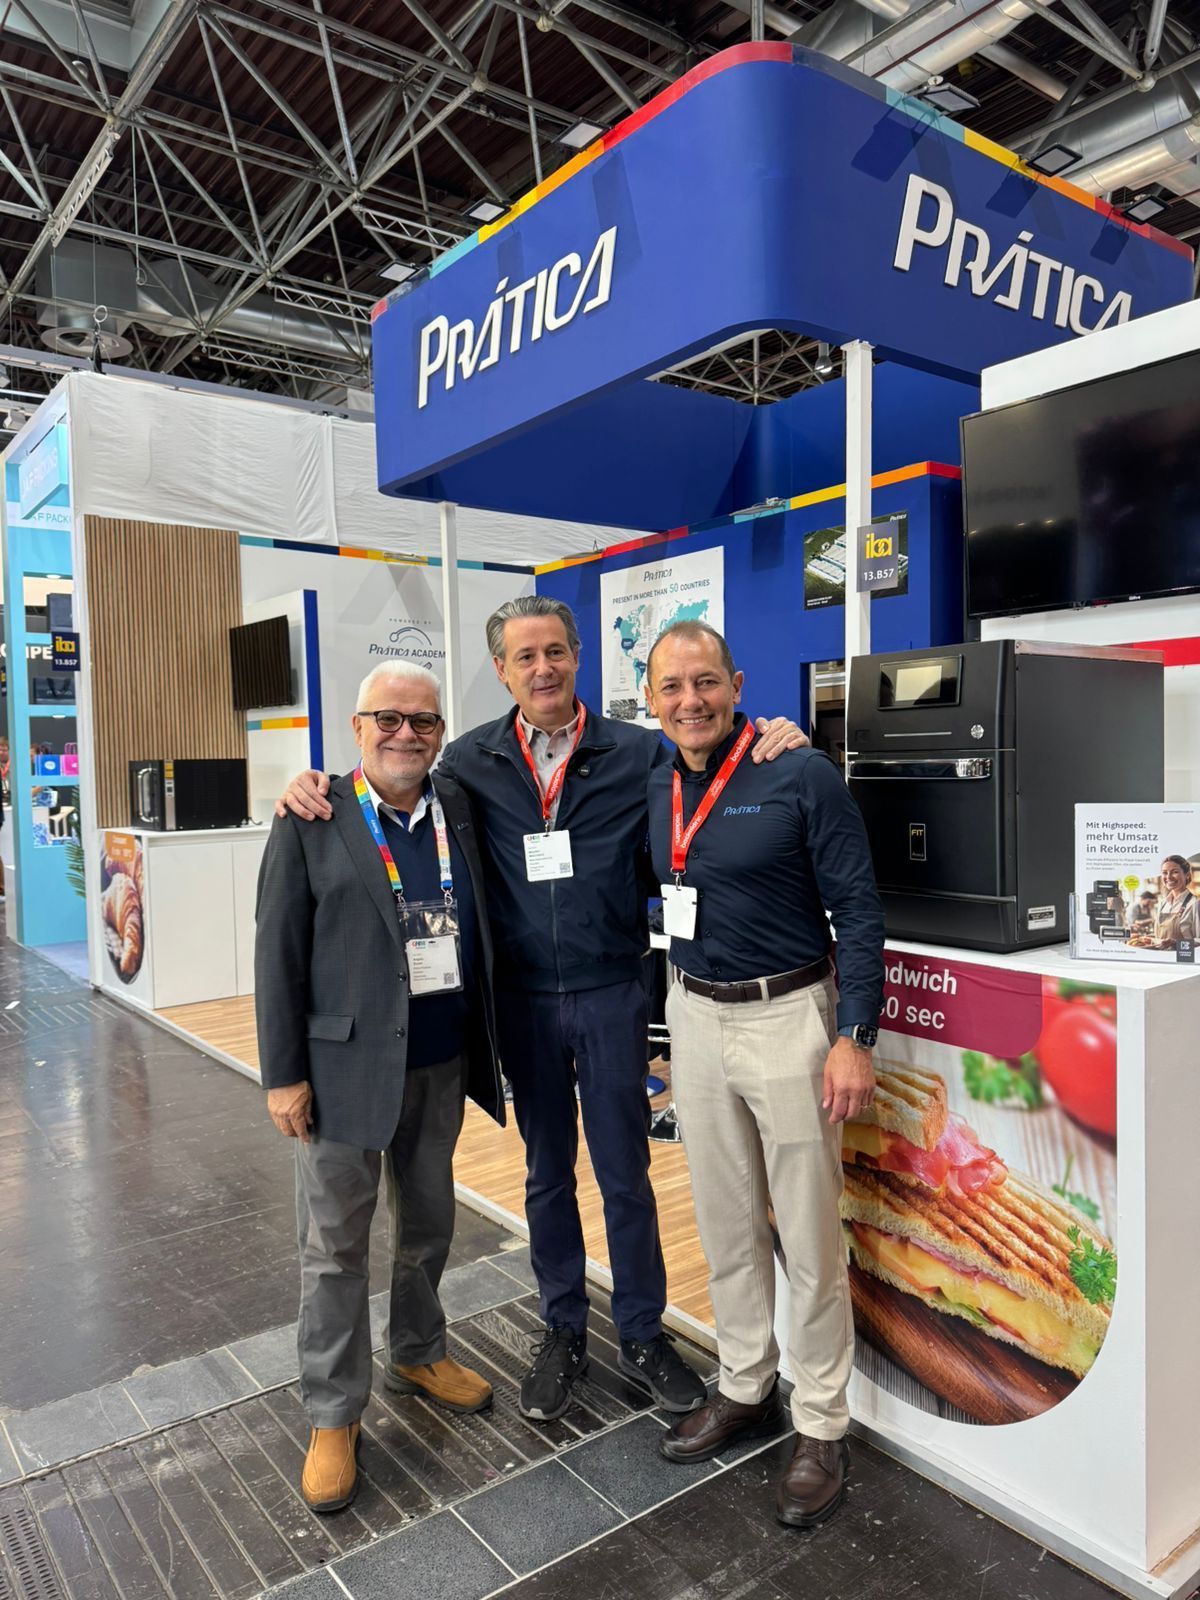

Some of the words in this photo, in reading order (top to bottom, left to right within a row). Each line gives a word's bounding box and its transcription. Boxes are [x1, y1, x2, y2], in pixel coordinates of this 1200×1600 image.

[418, 225, 617, 409] PRÁTICA
[865, 533, 893, 559] iba
[863, 568, 895, 581] 13.B57
[612, 594, 633, 605] PRESENT
[633, 592, 639, 600] IN
[639, 590, 653, 600] MORE
[653, 588, 668, 598] THAN
[669, 582, 679, 593] 50
[680, 579, 711, 591] COUNTRIES
[411, 649, 446, 659] ACADEM
[1086, 821, 1100, 829] Mit
[1101, 821, 1147, 830] Highspeed:
[1086, 832, 1115, 841] mehr
[1117, 832, 1159, 841] Umsatz
[1086, 843, 1097, 853] in
[1099, 844, 1159, 854] Rekordzeit
[880, 996, 899, 1019] 0
[905, 1005, 945, 1030] sec
